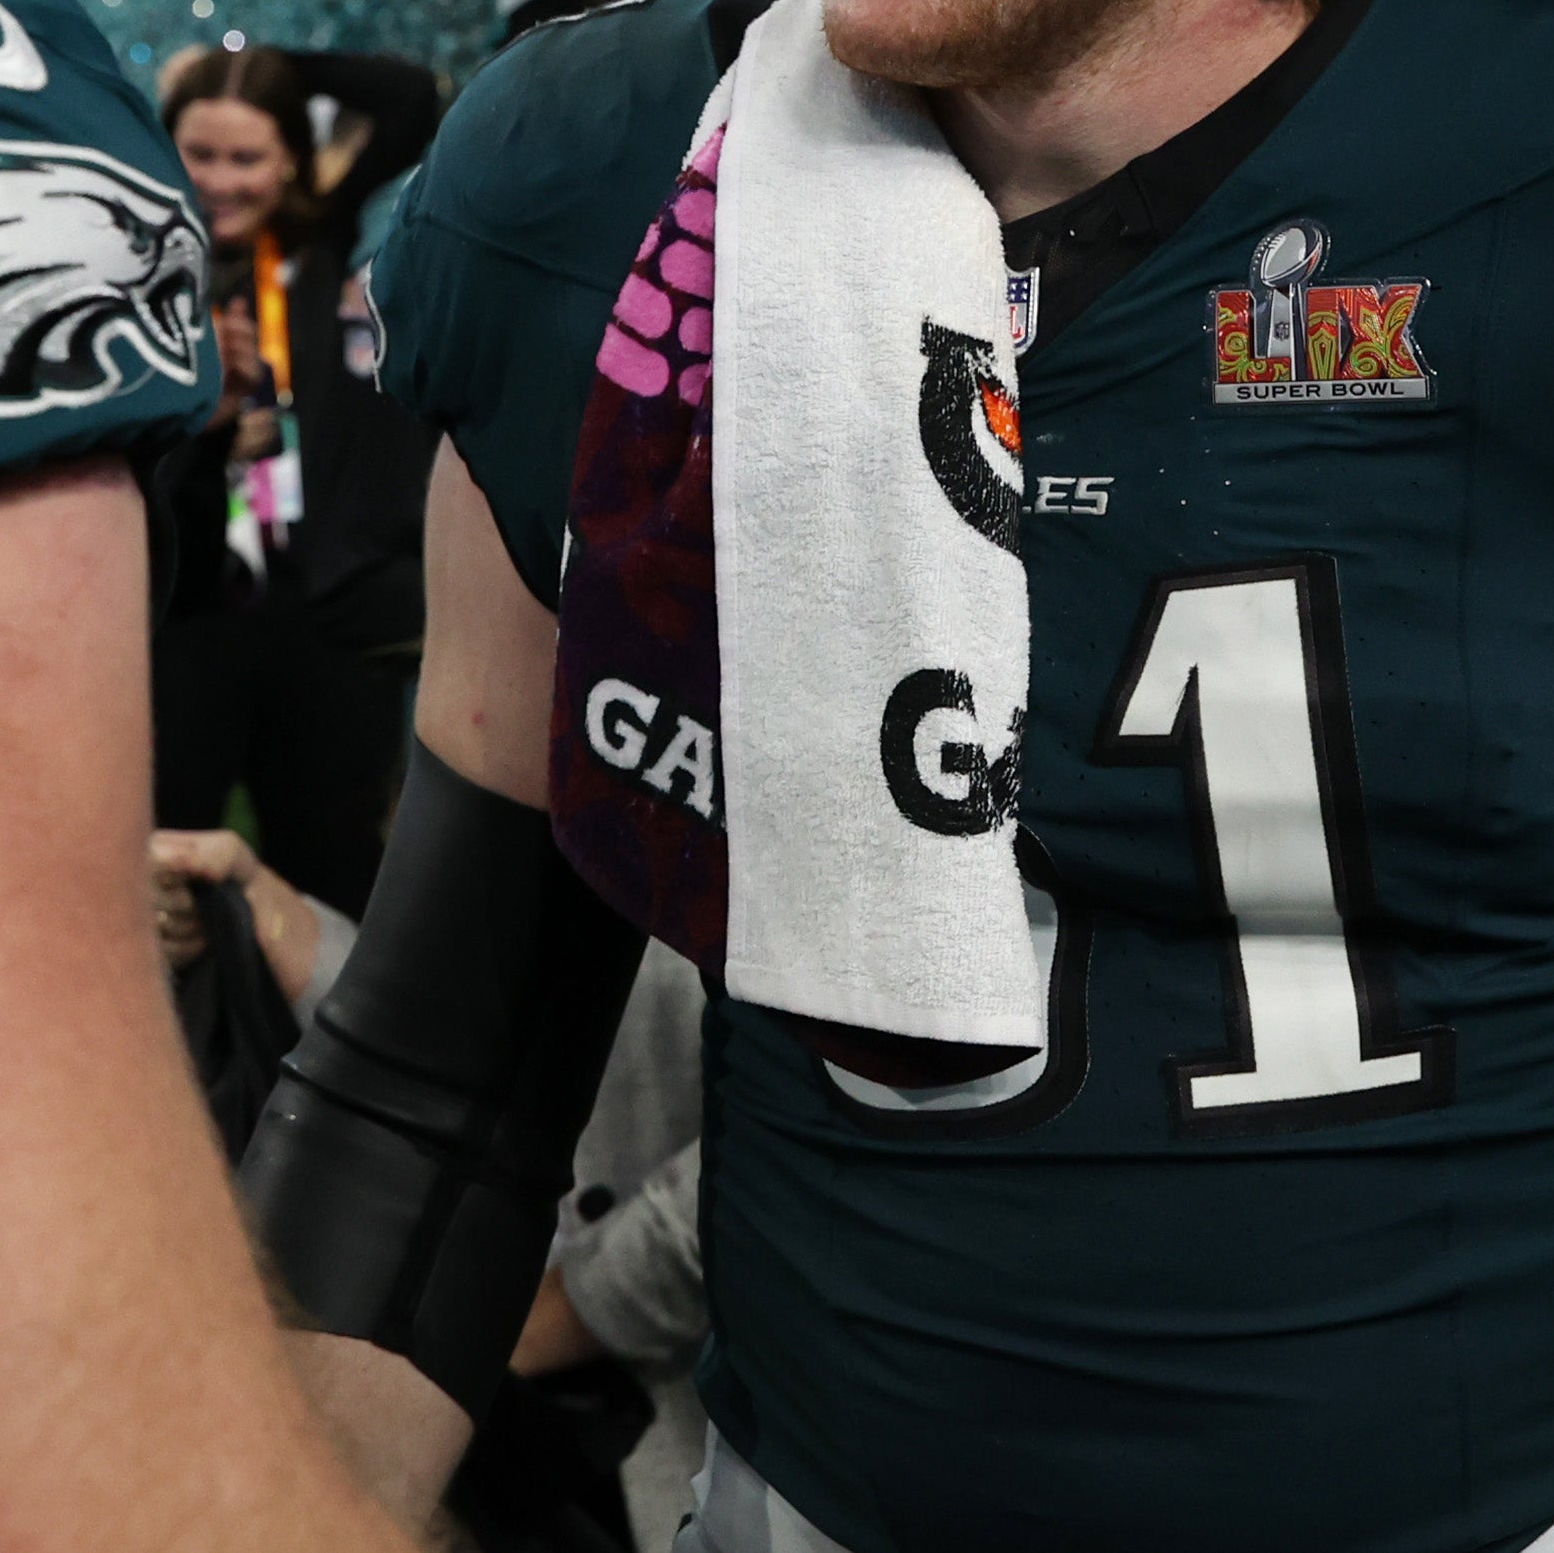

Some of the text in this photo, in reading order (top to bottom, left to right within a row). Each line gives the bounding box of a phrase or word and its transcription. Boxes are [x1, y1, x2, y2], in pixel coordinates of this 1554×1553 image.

[1216, 283, 1424, 383] LIX
[1236, 381, 1405, 400] SUPER BOWL
[1023, 476, 1115, 516] ES
